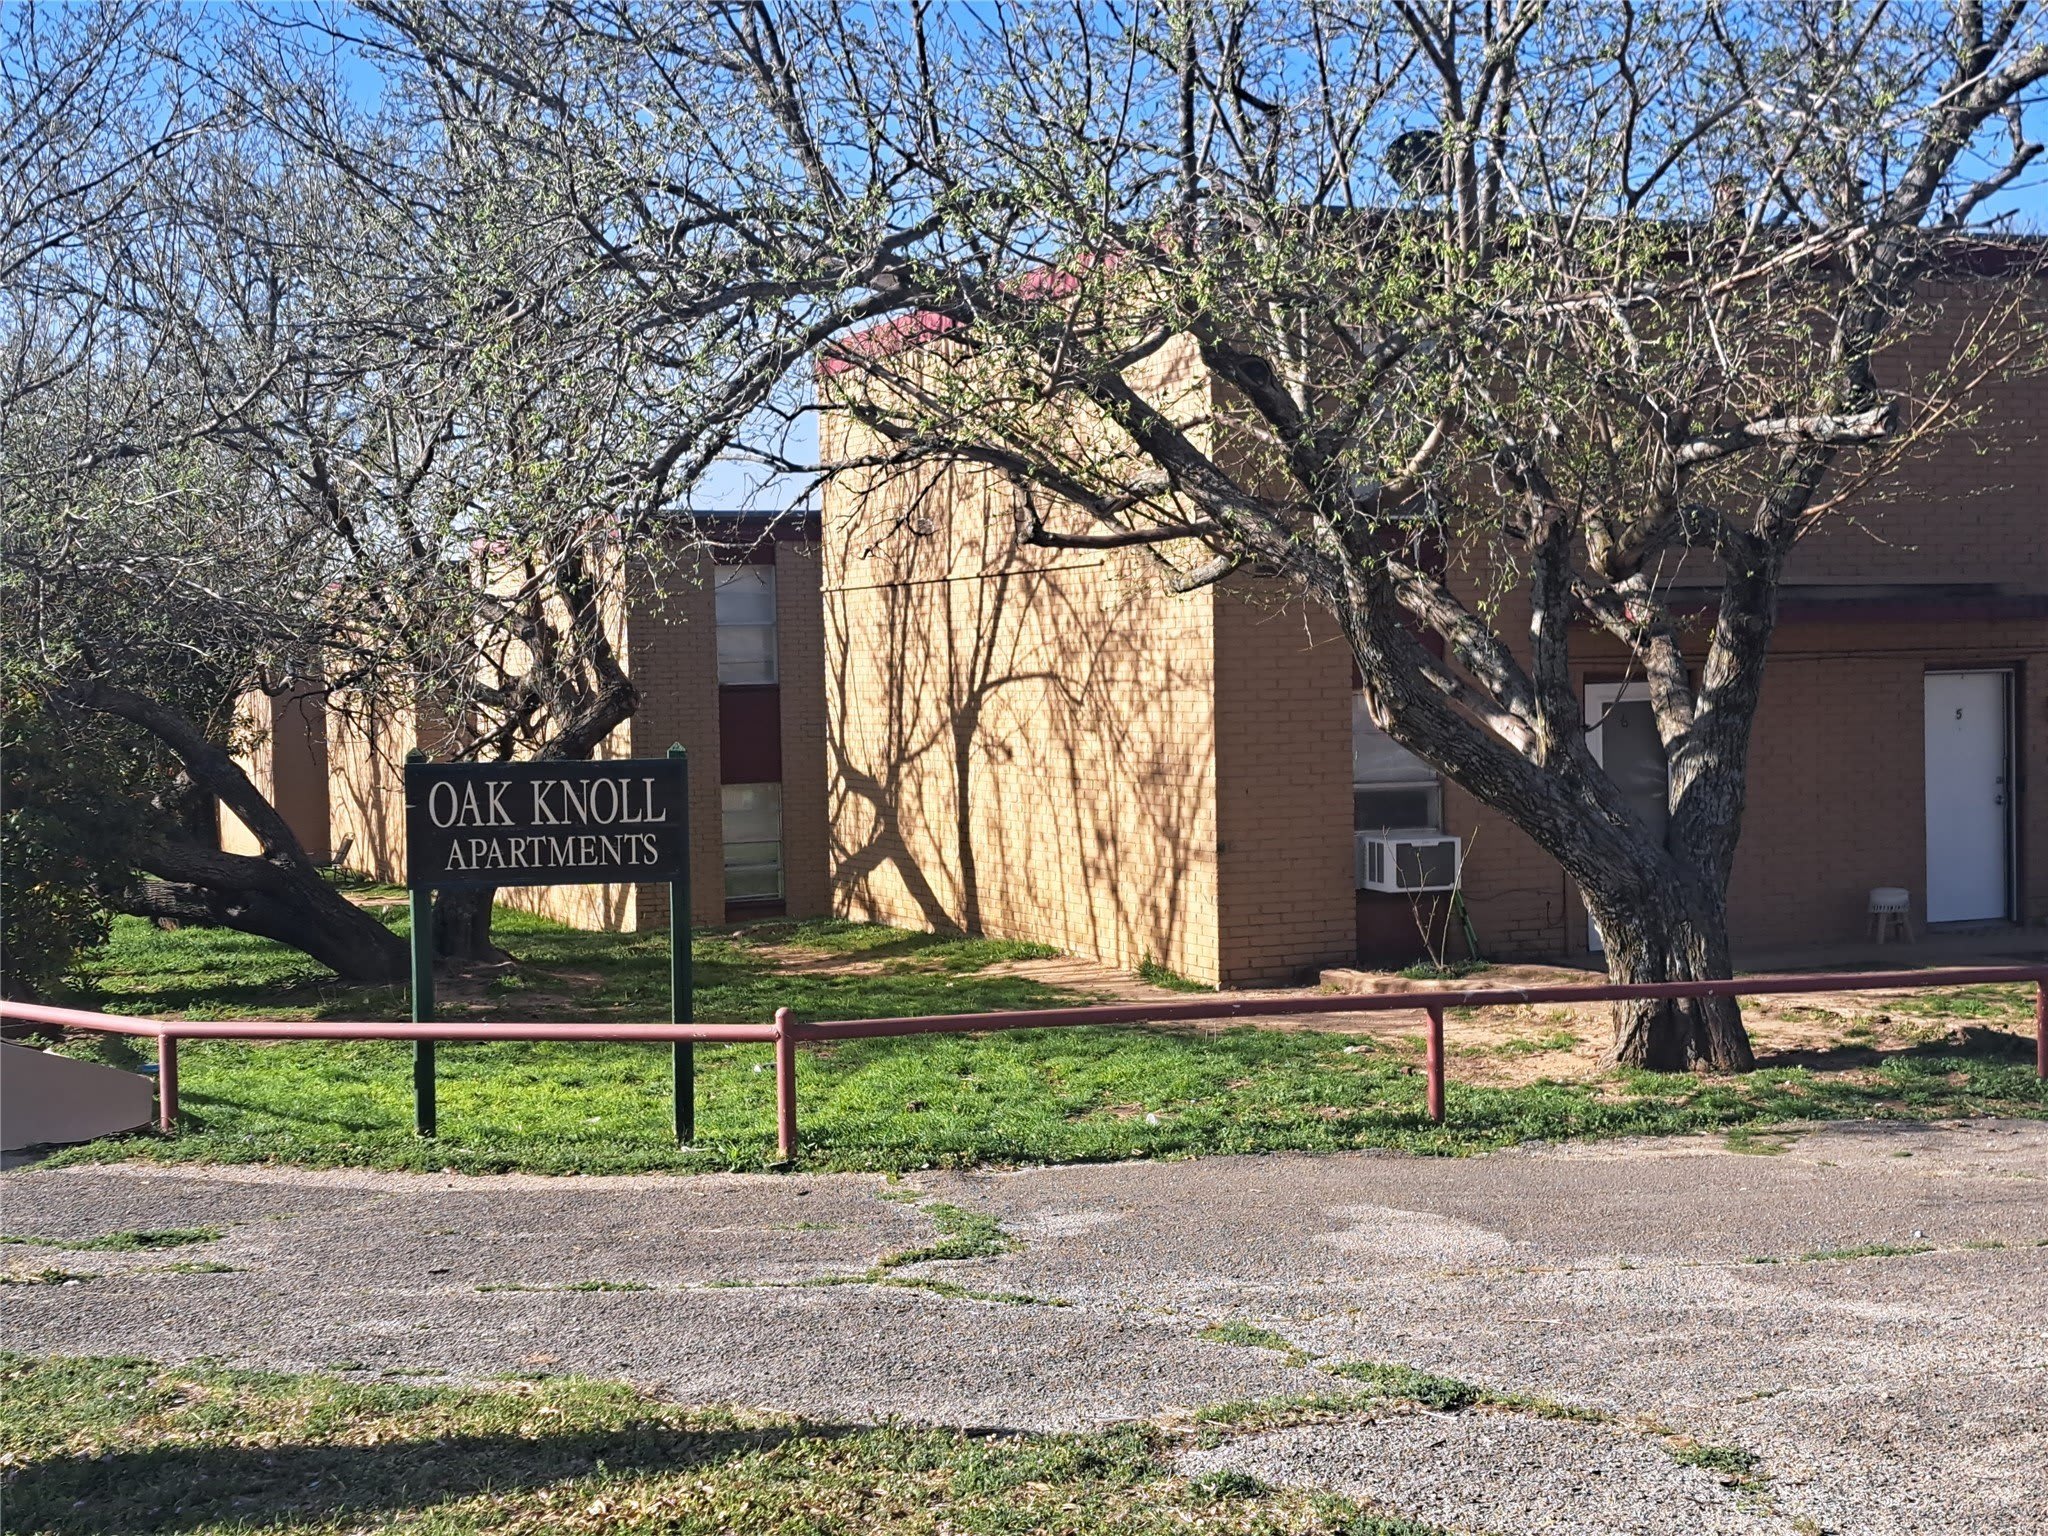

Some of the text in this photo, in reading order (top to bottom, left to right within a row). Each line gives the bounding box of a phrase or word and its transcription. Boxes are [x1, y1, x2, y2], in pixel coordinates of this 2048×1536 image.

[1956, 708, 1963, 720] 5
[428, 777, 667, 829] OAK KNOLL
[444, 833, 659, 871] APARTMENTS
